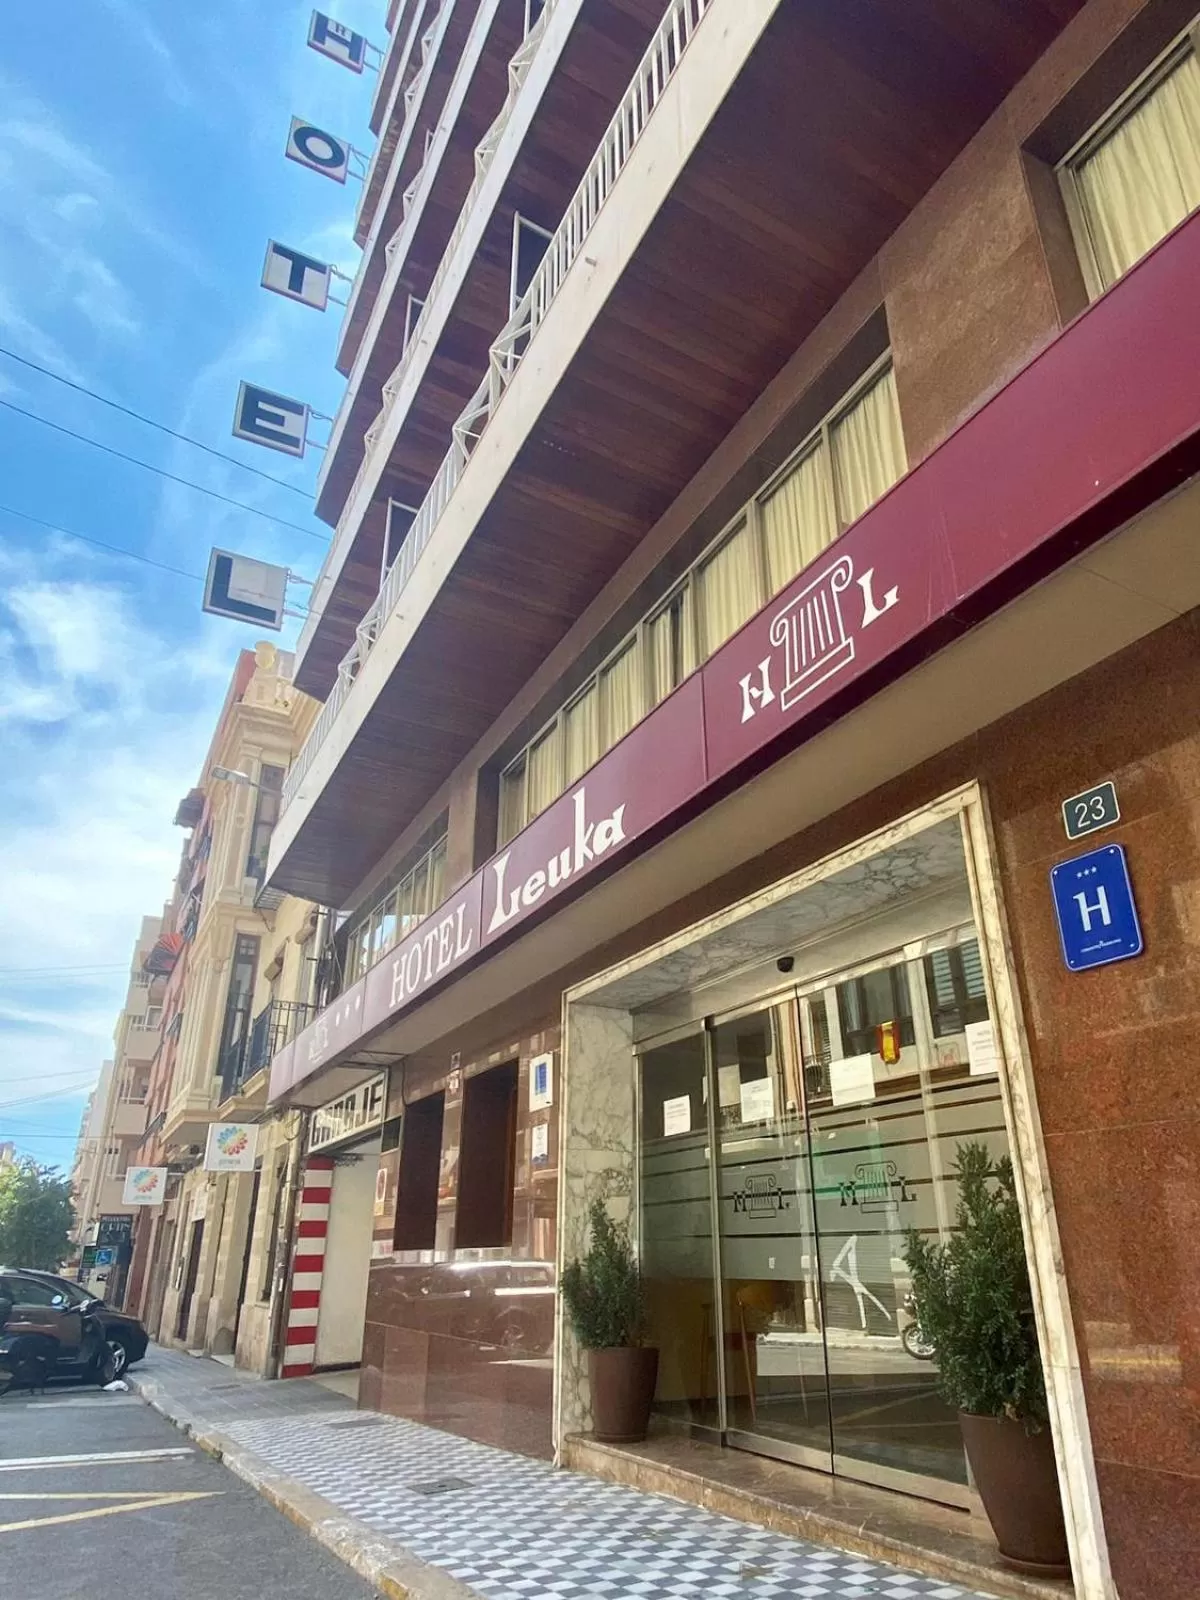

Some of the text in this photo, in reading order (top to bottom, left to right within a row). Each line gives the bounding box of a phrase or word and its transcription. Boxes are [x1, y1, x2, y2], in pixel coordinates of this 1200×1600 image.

[1074, 795, 1106, 828] 23
[389, 786, 626, 1008] HOTEL Leuka
[1073, 885, 1112, 932] H
